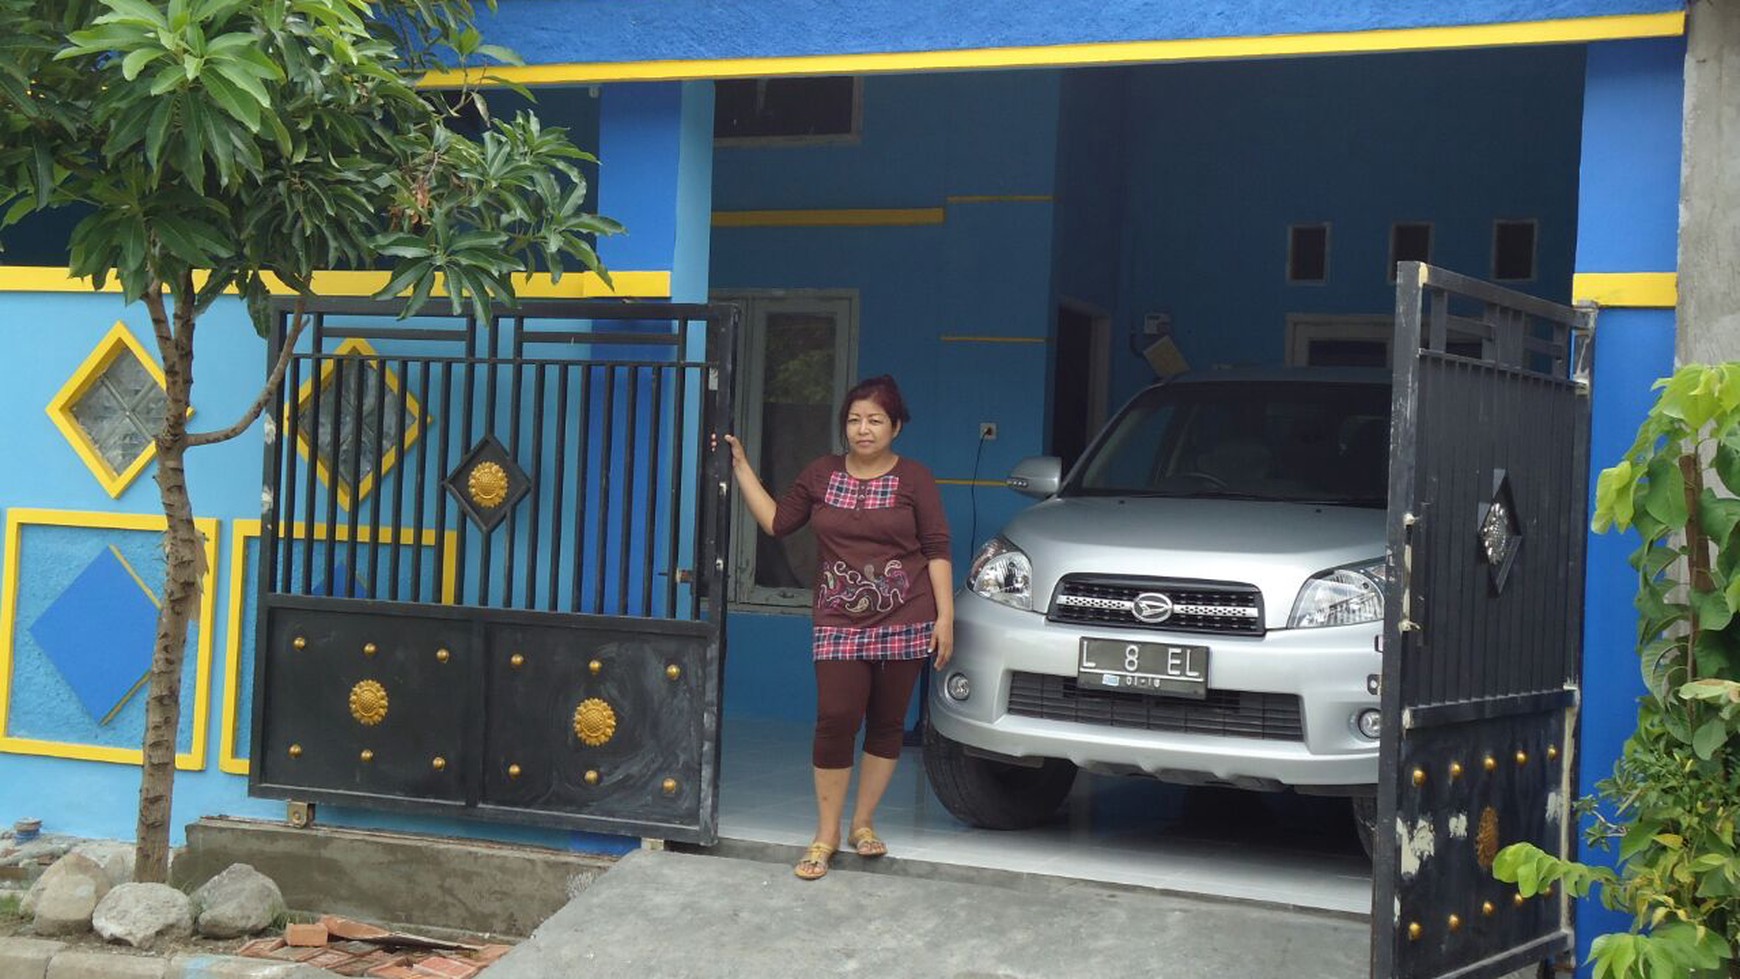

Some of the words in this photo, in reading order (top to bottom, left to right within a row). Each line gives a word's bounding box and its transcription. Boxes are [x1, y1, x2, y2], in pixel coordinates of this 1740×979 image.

[1082, 641, 1096, 667] L
[1126, 645, 1139, 671] 8
[1167, 648, 1200, 676] EL
